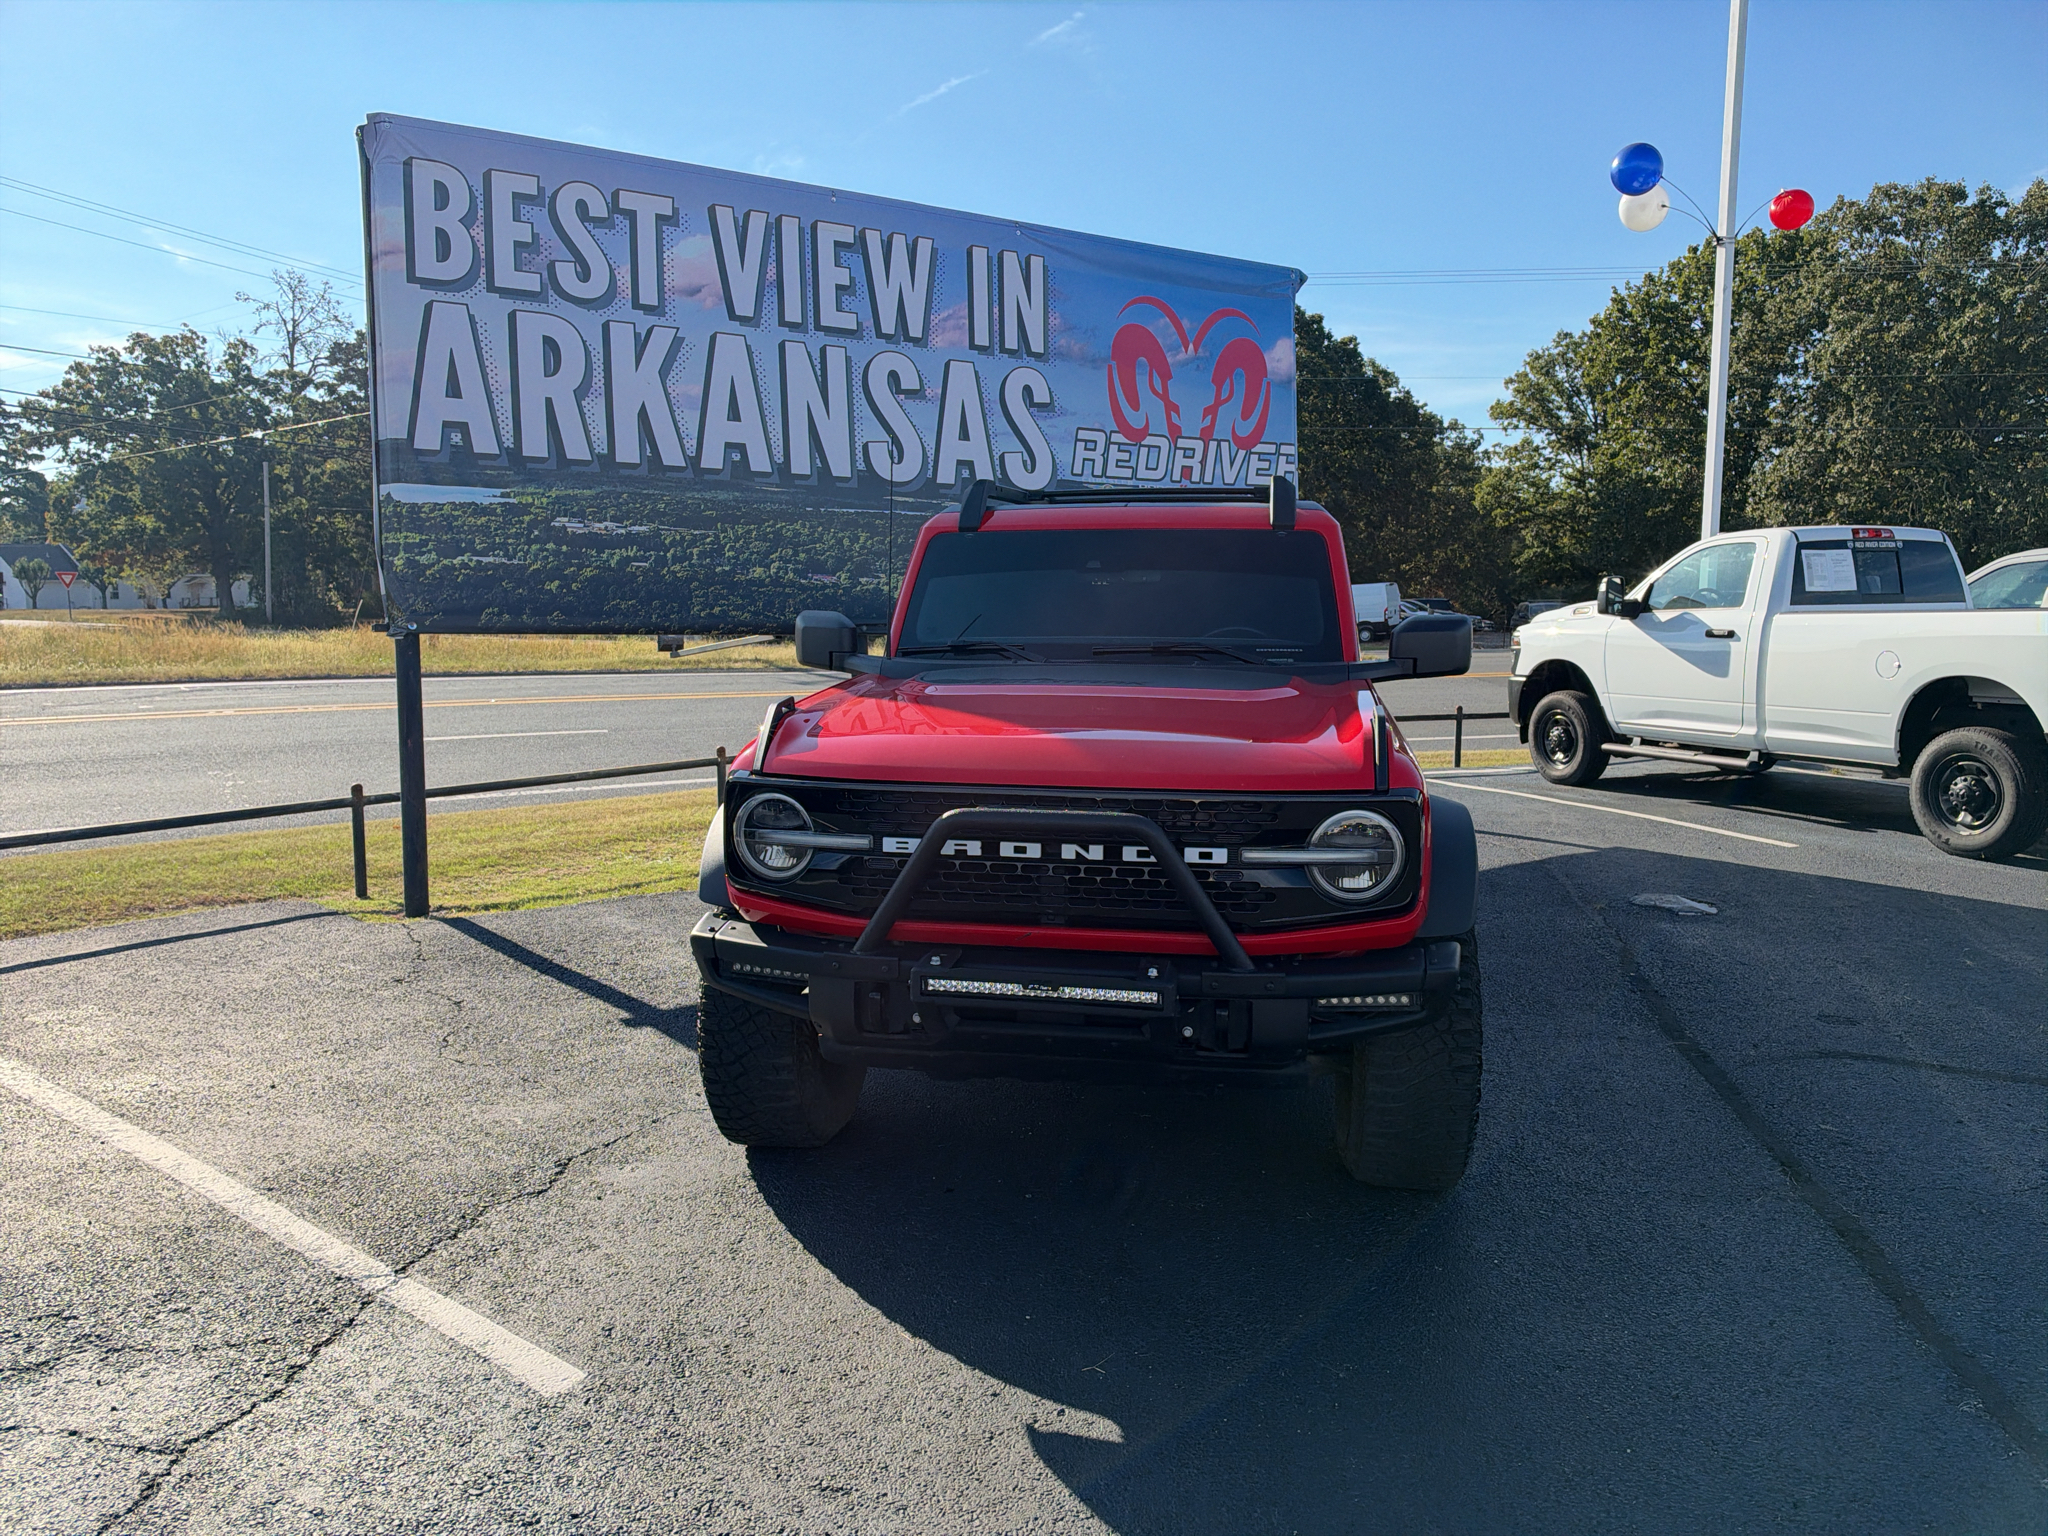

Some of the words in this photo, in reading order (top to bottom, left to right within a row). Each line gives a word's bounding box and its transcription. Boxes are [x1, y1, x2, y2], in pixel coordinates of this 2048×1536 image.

[403, 156, 677, 313] BEST
[708, 203, 934, 344] VIEW
[967, 244, 1047, 358] IN
[407, 300, 1056, 490] ARKANSAS
[882, 836, 1228, 864] BRONCO
